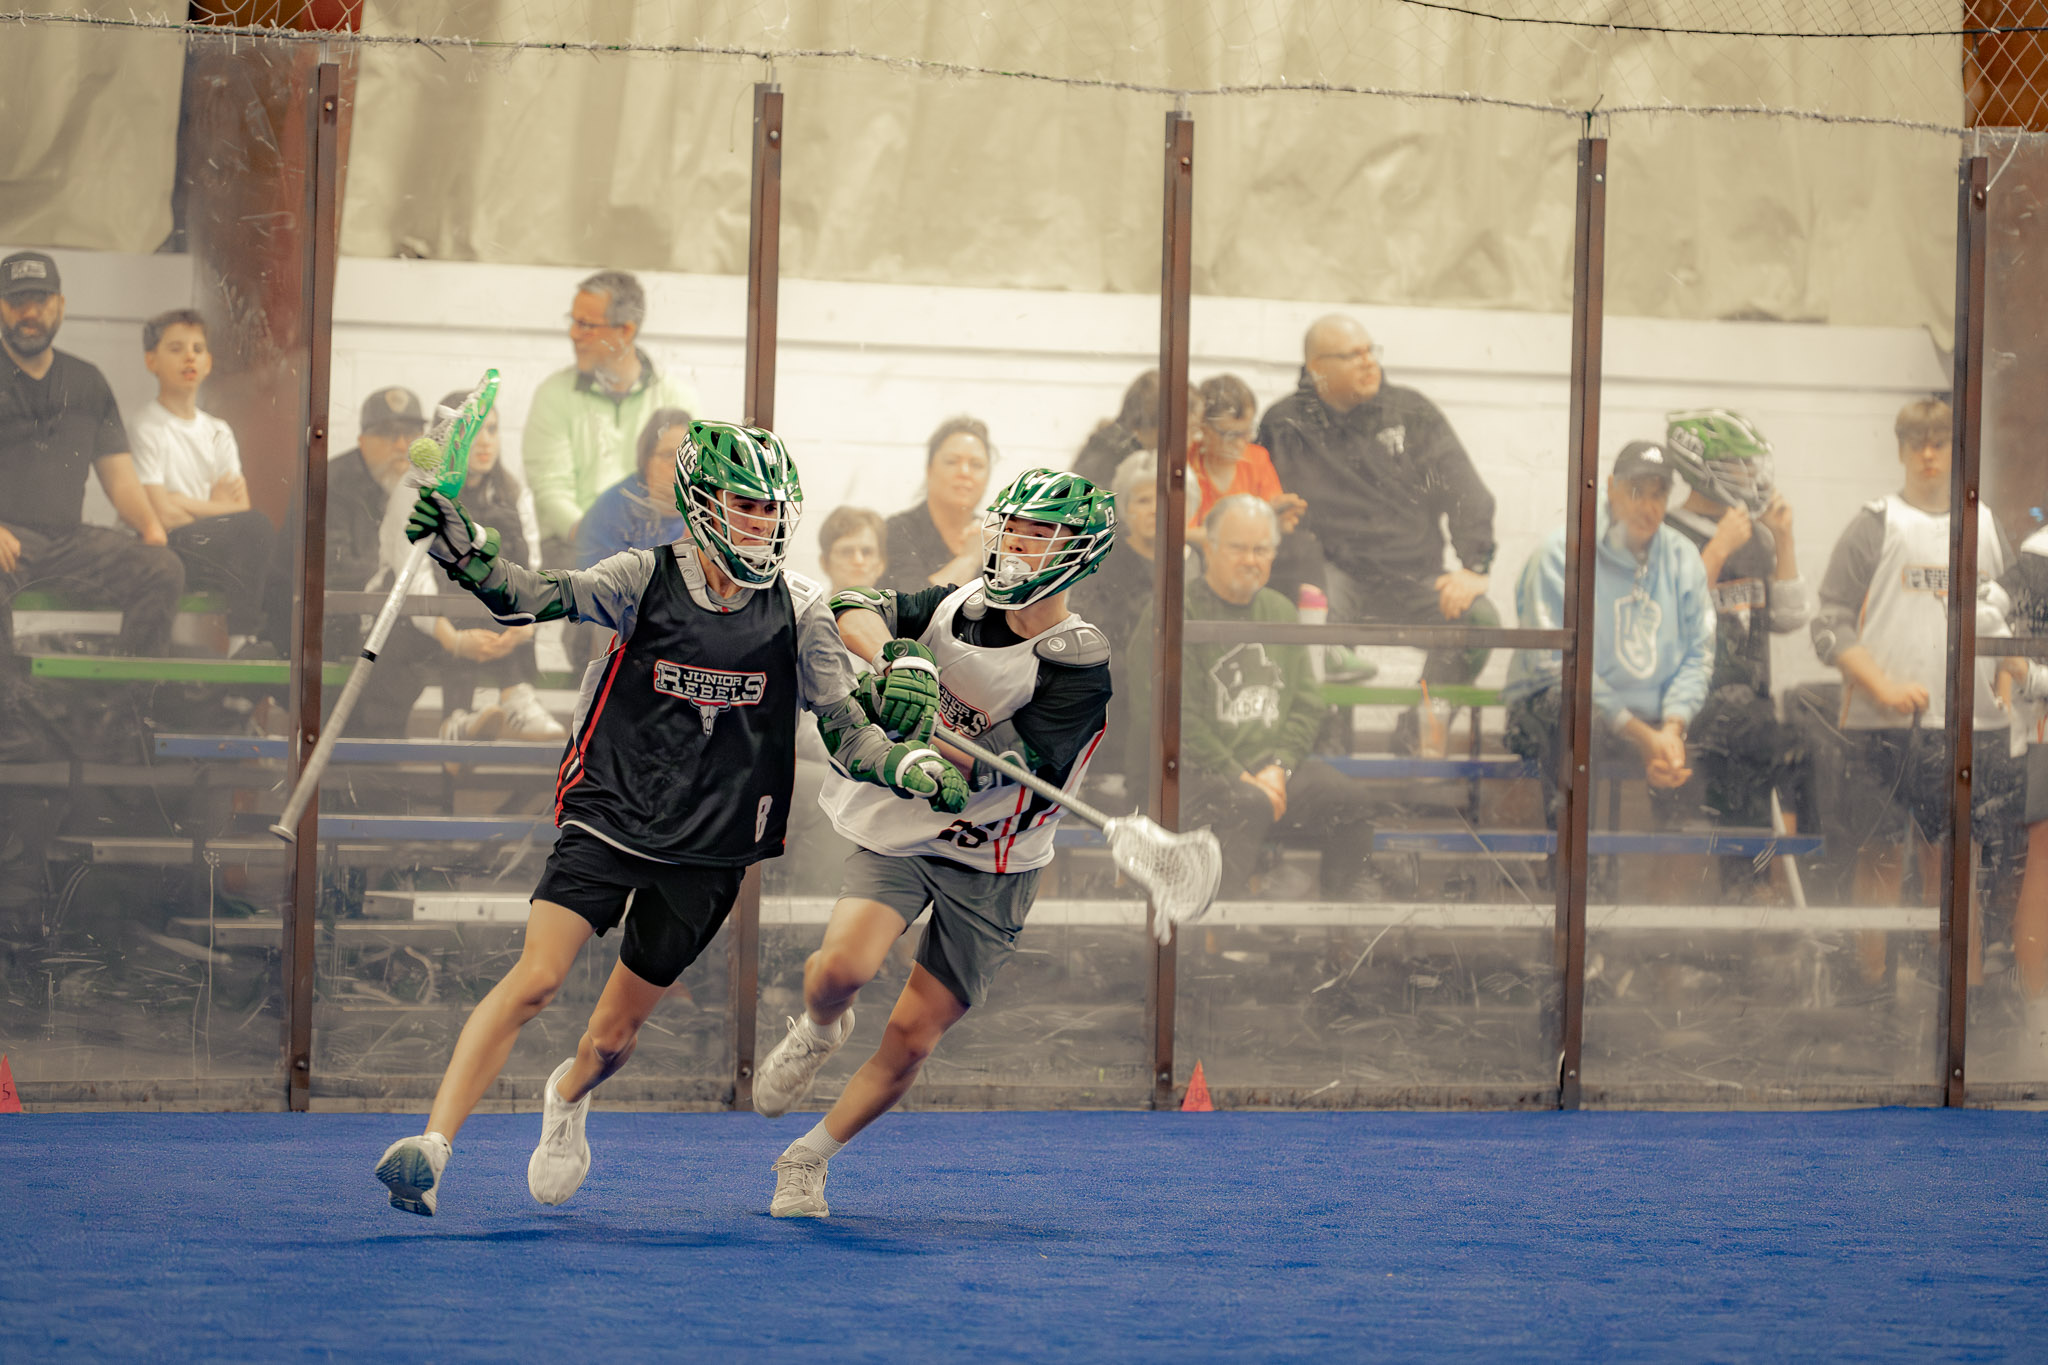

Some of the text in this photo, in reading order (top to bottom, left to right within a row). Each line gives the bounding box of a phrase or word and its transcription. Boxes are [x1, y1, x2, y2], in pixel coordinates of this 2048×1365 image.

[678, 433, 698, 475] CATS
[1104, 506, 1115, 527] 13
[656, 663, 764, 701] REBELS
[683, 671, 742, 687] JUNIOR
[940, 684, 970, 718] NIOR
[940, 695, 986, 737] BELS
